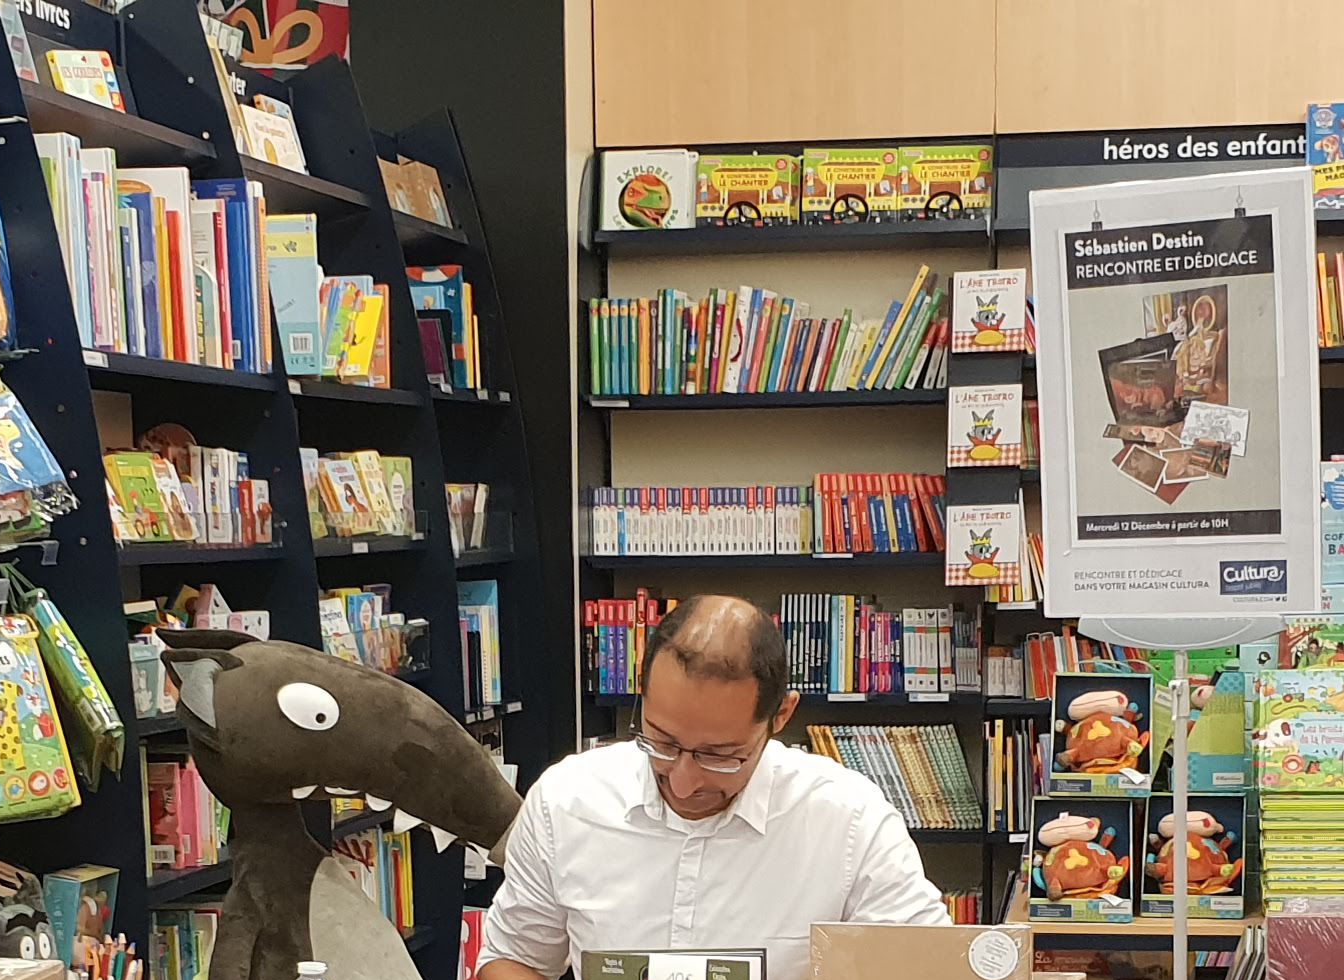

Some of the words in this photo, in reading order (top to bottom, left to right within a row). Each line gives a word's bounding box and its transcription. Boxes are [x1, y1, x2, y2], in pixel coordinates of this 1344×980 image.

[35, 1, 71, 29] livres
[1103, 138, 1170, 160] héros
[1176, 136, 1219, 158] des
[1225, 134, 1308, 156] enfant
[616, 165, 673, 185] EXPLORE!
[837, 173, 876, 181] CHANTIER
[932, 170, 971, 179] CHANTIER
[1314, 165, 1334, 177] MES
[730, 179, 769, 187] CHANTIER
[1074, 236, 1148, 257] Sébastien
[1152, 231, 1204, 249] Destin
[1076, 259, 1162, 279] RENCONTRE
[1165, 257, 1181, 271] ET
[1184, 250, 1258, 270] DÉDICACE
[987, 276, 1019, 288] TROTRO
[983, 391, 1014, 402] TROTRO
[980, 511, 1012, 521] TROTRO
[1086, 522, 1119, 532] Mercredi
[1120, 522, 1129, 531] 12
[1131, 521, 1169, 531] Décembre
[1177, 520, 1199, 532] partir
[1211, 518, 1229, 529] 10H
[1074, 571, 1126, 580] RENCONTRE
[1139, 568, 1182, 579] DÉDICACE
[1223, 565, 1285, 583] Cultura
[1074, 582, 1098, 591] DANS
[1099, 582, 1127, 591] VOTRE
[1128, 581, 1168, 590] MAGASIN
[1170, 580, 1209, 590] CULTURA
